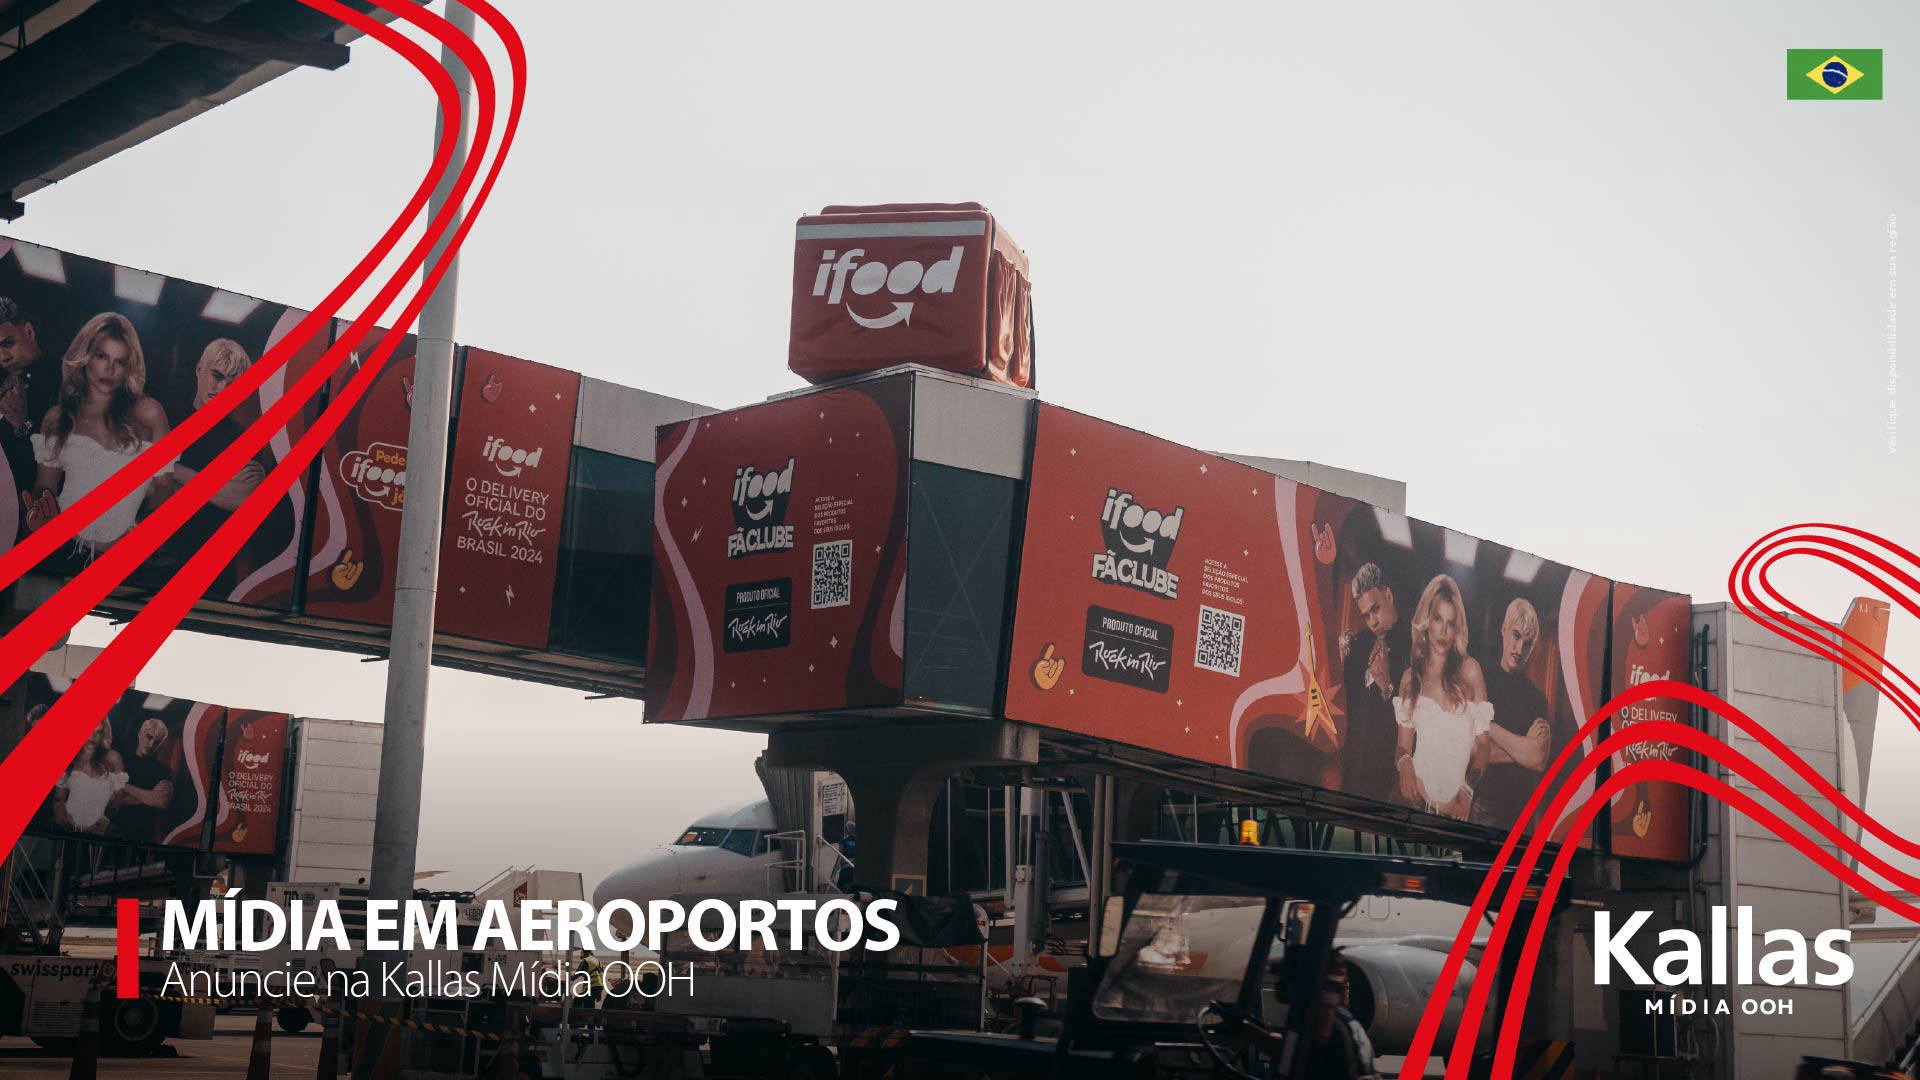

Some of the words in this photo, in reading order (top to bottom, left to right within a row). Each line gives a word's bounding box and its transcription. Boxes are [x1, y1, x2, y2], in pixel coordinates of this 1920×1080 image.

[812, 246, 965, 305] ifood
[375, 449, 406, 466] Pede
[482, 435, 543, 468] ifood
[466, 477, 477, 491] O
[481, 480, 550, 506] DELIVERY
[733, 458, 795, 507] ifood
[464, 493, 521, 517] OFICIAL
[525, 505, 546, 521] DO
[1101, 488, 1184, 541] ifood
[461, 510, 503, 538] Rock
[502, 522, 517, 537] in
[515, 520, 547, 546] Rio
[457, 536, 507, 557] BRASIL
[510, 545, 543, 564] 2024
[736, 589, 761, 604] PRODUTO
[760, 586, 781, 601] OFICIAL
[727, 615, 756, 642] Rock
[755, 619, 766, 633] in
[764, 612, 788, 639] Rio
[1102, 616, 1134, 635] PRODUTO
[1134, 624, 1159, 641] OFICIAL
[1088, 640, 1128, 671] Rock
[1126, 653, 1140, 671] in
[1138, 651, 1167, 681] Rio
[1621, 706, 1630, 719] O
[1631, 706, 1678, 723] DELIVERY
[237, 749, 270, 764] ifood
[228, 771, 236, 780] O
[236, 772, 274, 782] DELIVERY
[228, 780, 259, 789] OFICIAL
[260, 782, 273, 791] DO
[253, 804, 272, 813] 2024
[10, 958, 99, 981] swissport
